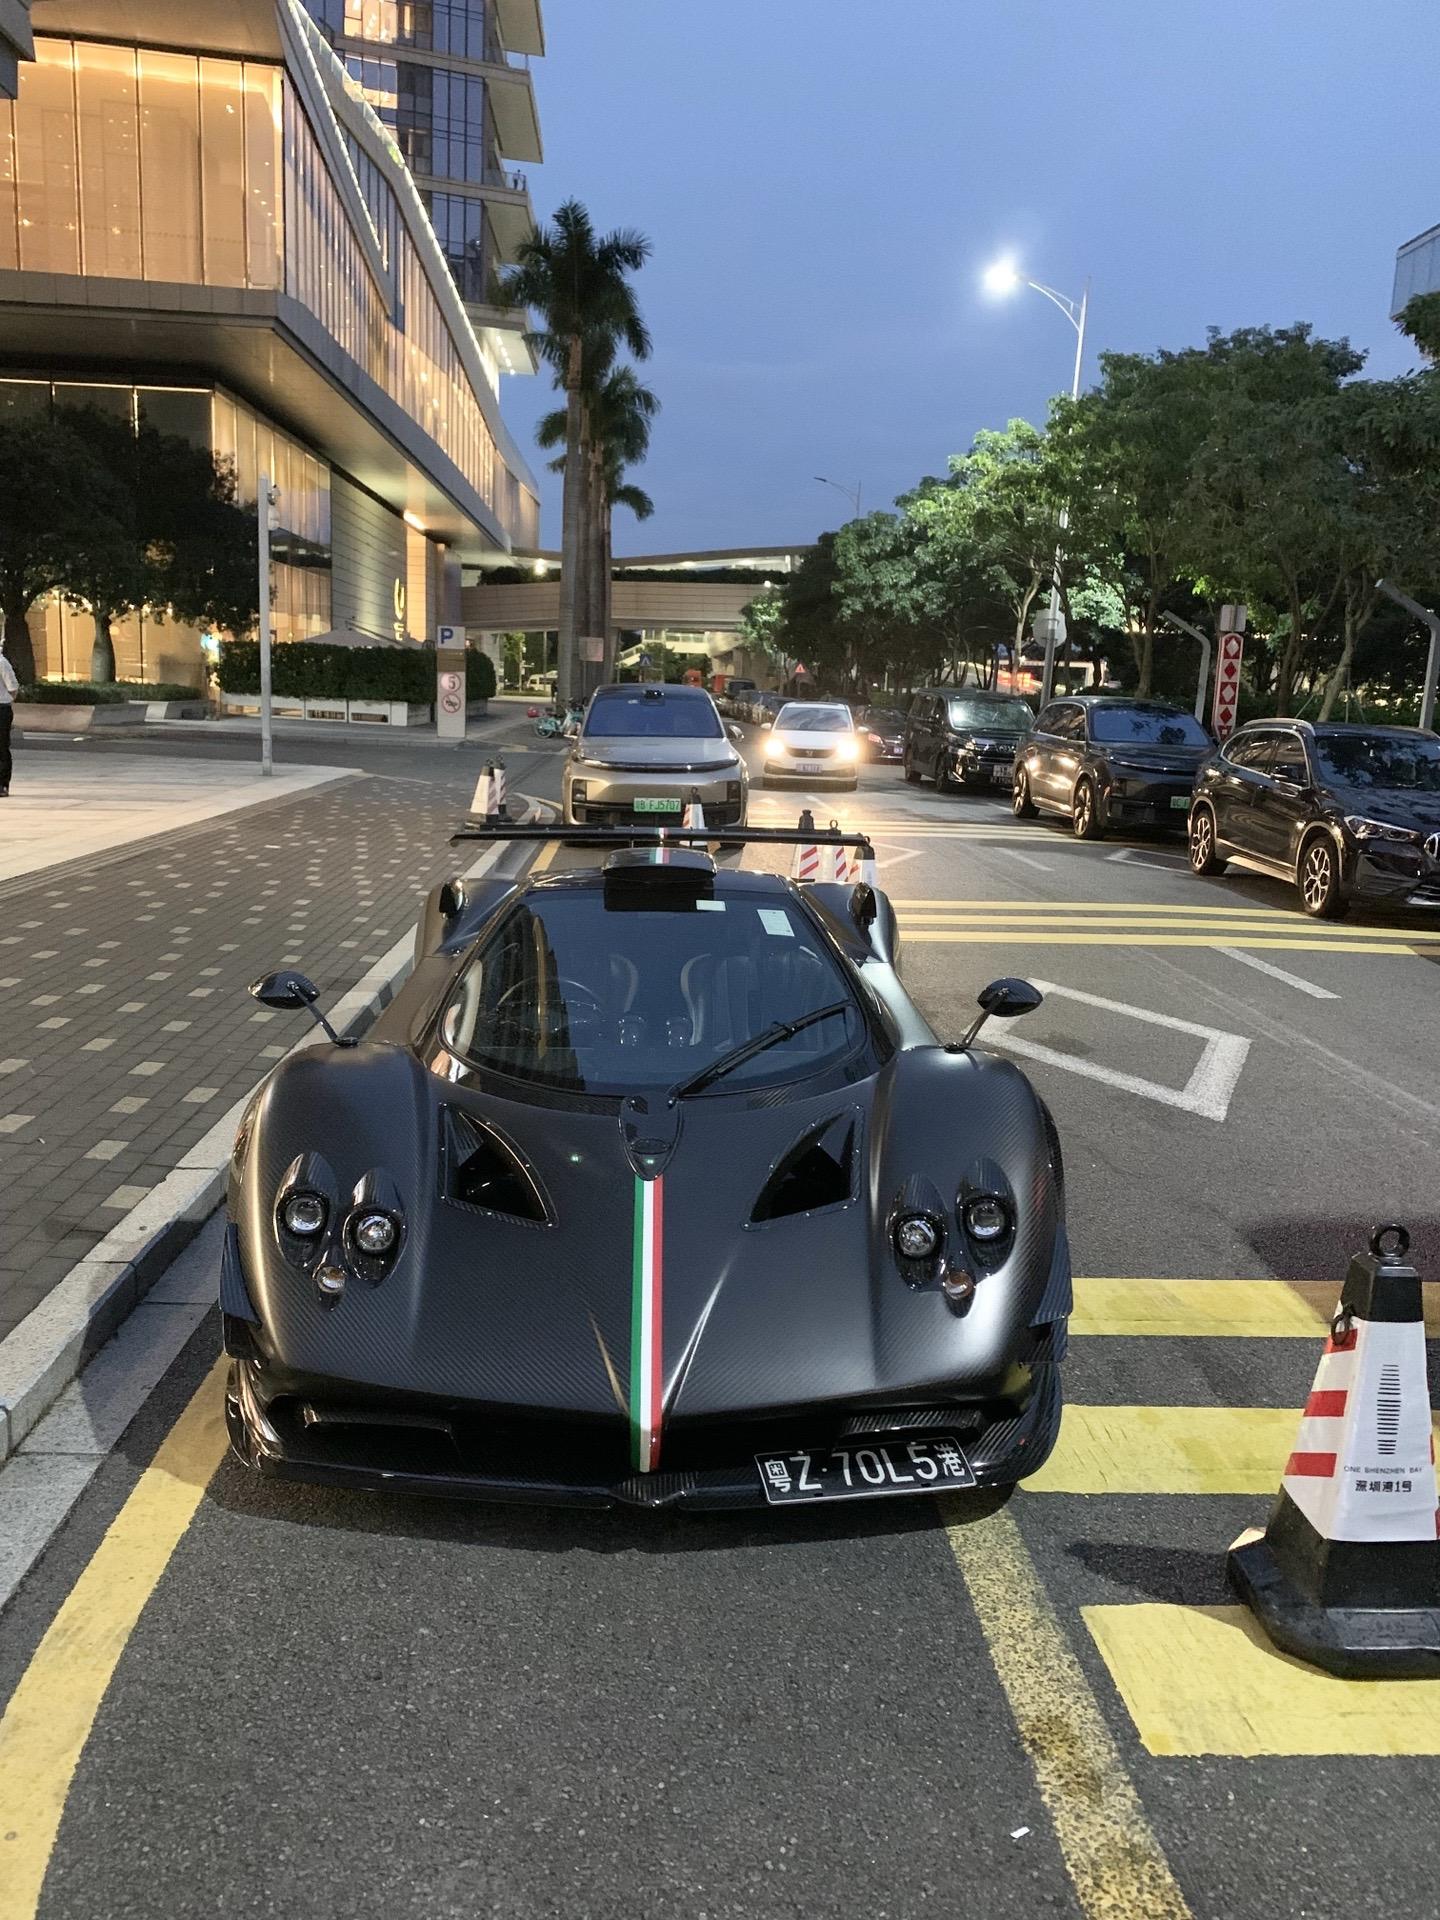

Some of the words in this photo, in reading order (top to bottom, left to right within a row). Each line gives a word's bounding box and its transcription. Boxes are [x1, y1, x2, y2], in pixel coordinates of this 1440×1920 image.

[441, 628, 453, 644] P
[448, 676, 456, 690] 5
[1344, 1465, 1361, 1473] ONE
[1364, 1466, 1405, 1474] SHENZHEN
[1409, 1466, 1422, 1474] BAY
[1355, 1480, 1412, 1493] 深圳湾1号
